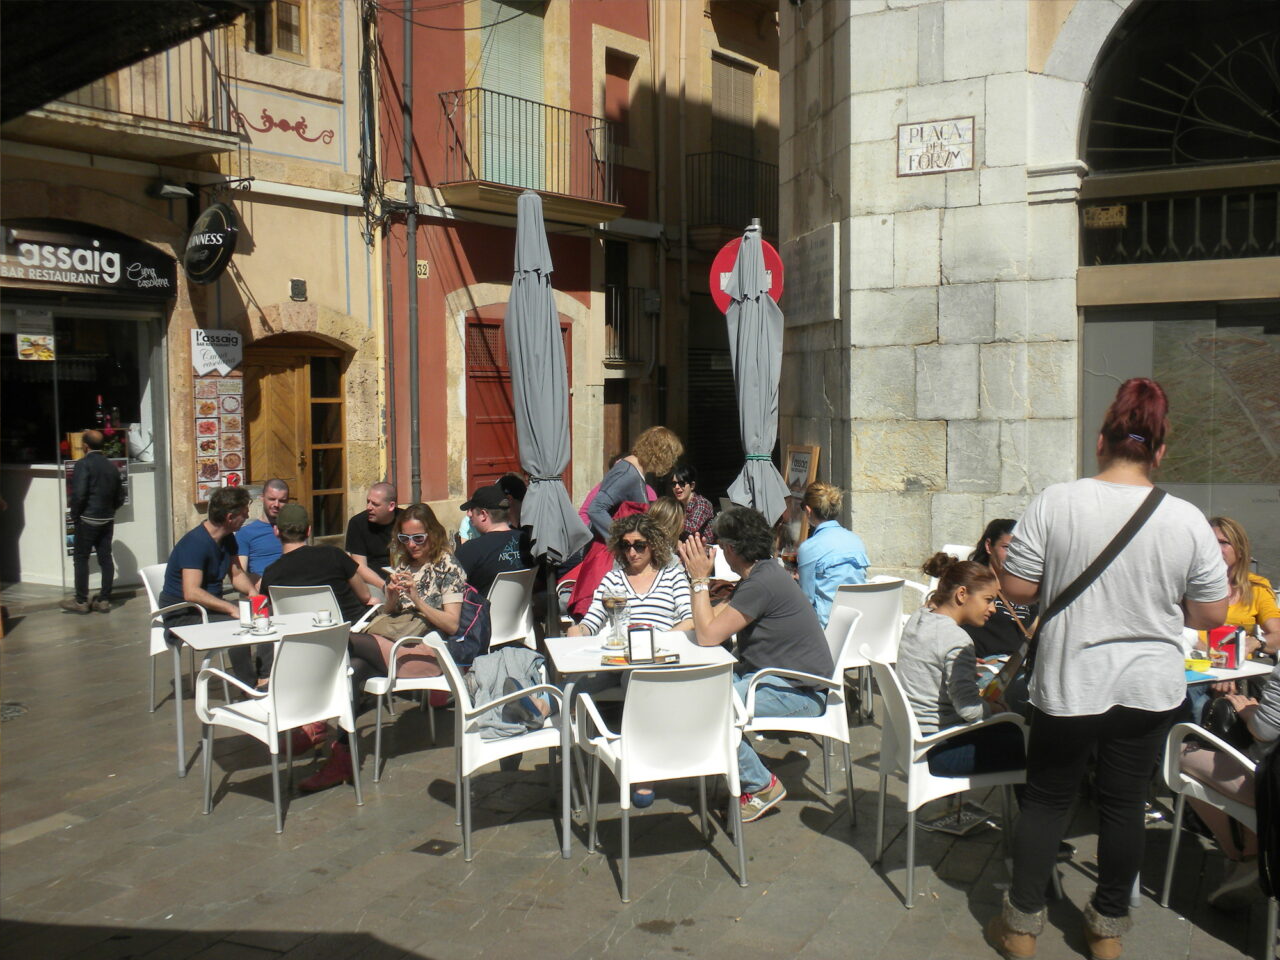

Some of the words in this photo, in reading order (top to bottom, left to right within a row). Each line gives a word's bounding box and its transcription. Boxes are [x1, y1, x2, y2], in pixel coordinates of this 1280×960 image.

[186, 233, 223, 250] INNESS
[1, 266, 24, 278] BAR
[29, 268, 100, 284] RESTAURANT
[417, 264, 428, 276] 32
[196, 330, 239, 347] l'assaig
